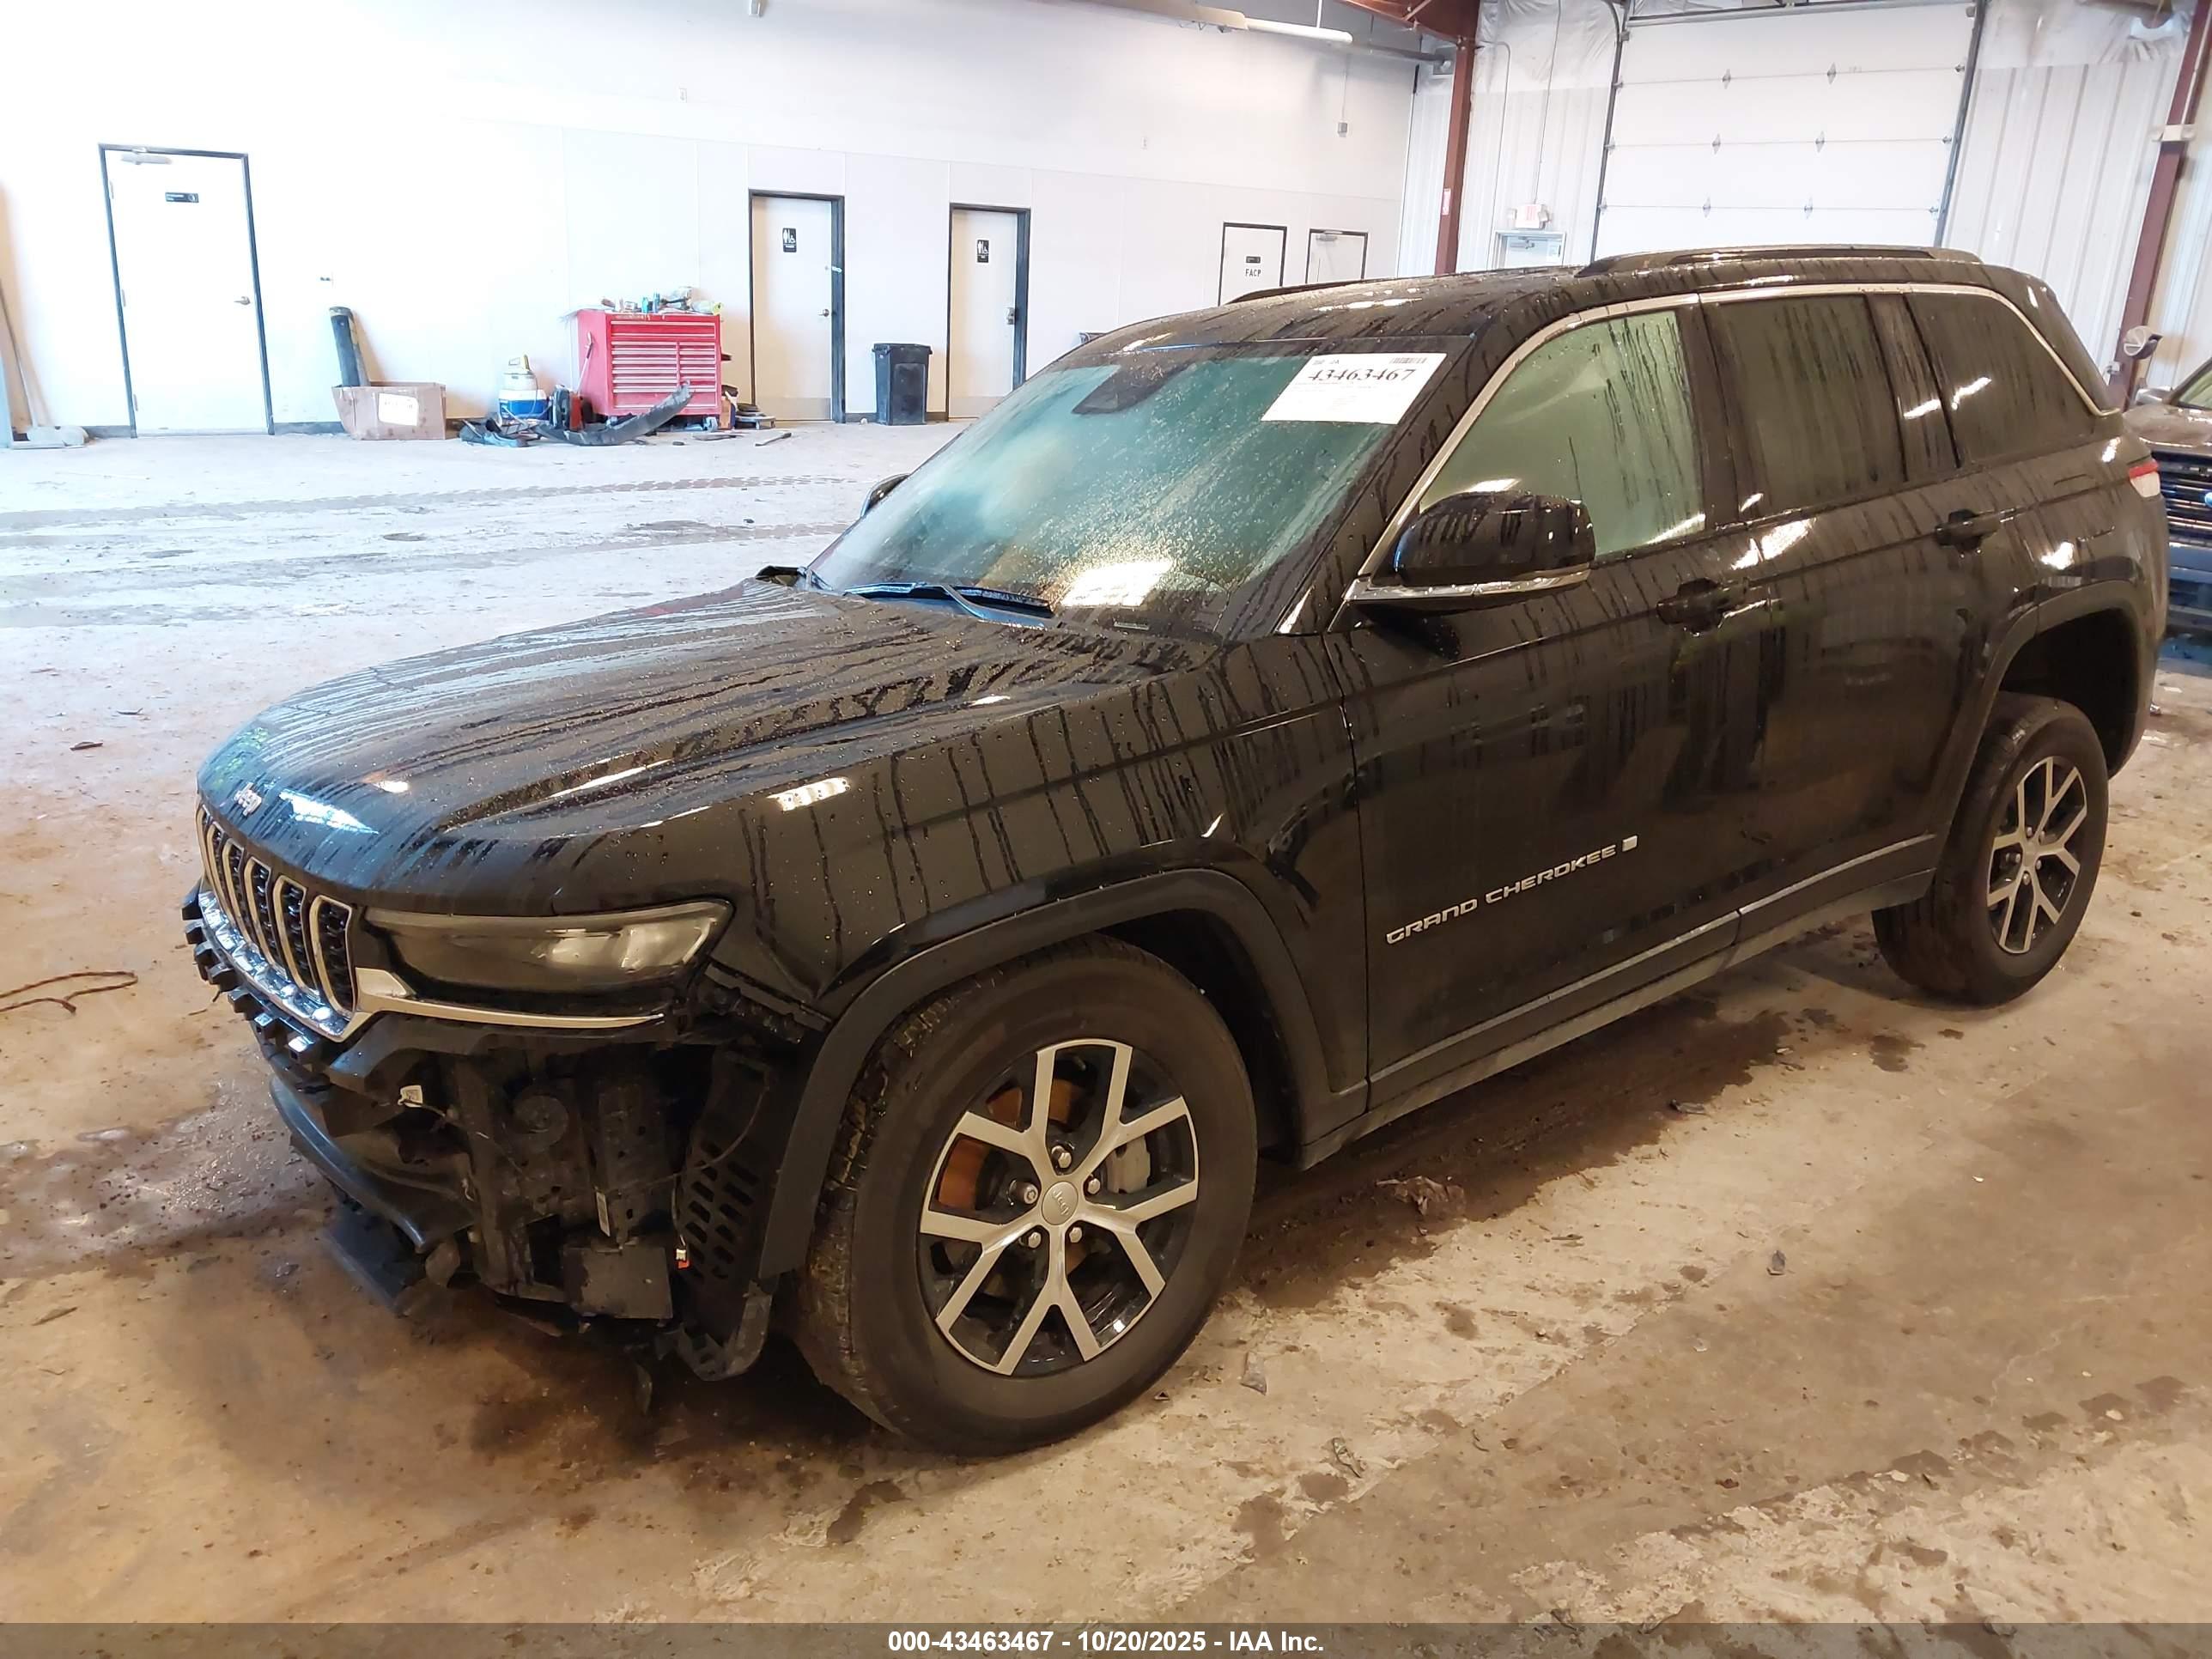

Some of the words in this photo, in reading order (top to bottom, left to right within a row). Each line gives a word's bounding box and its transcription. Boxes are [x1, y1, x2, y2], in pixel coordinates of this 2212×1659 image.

[1245, 268, 1261, 277] FACP
[1308, 368, 1417, 381] 43463467
[1386, 898, 1478, 945] GRAND
[1486, 844, 1616, 904] CHEROKEE
